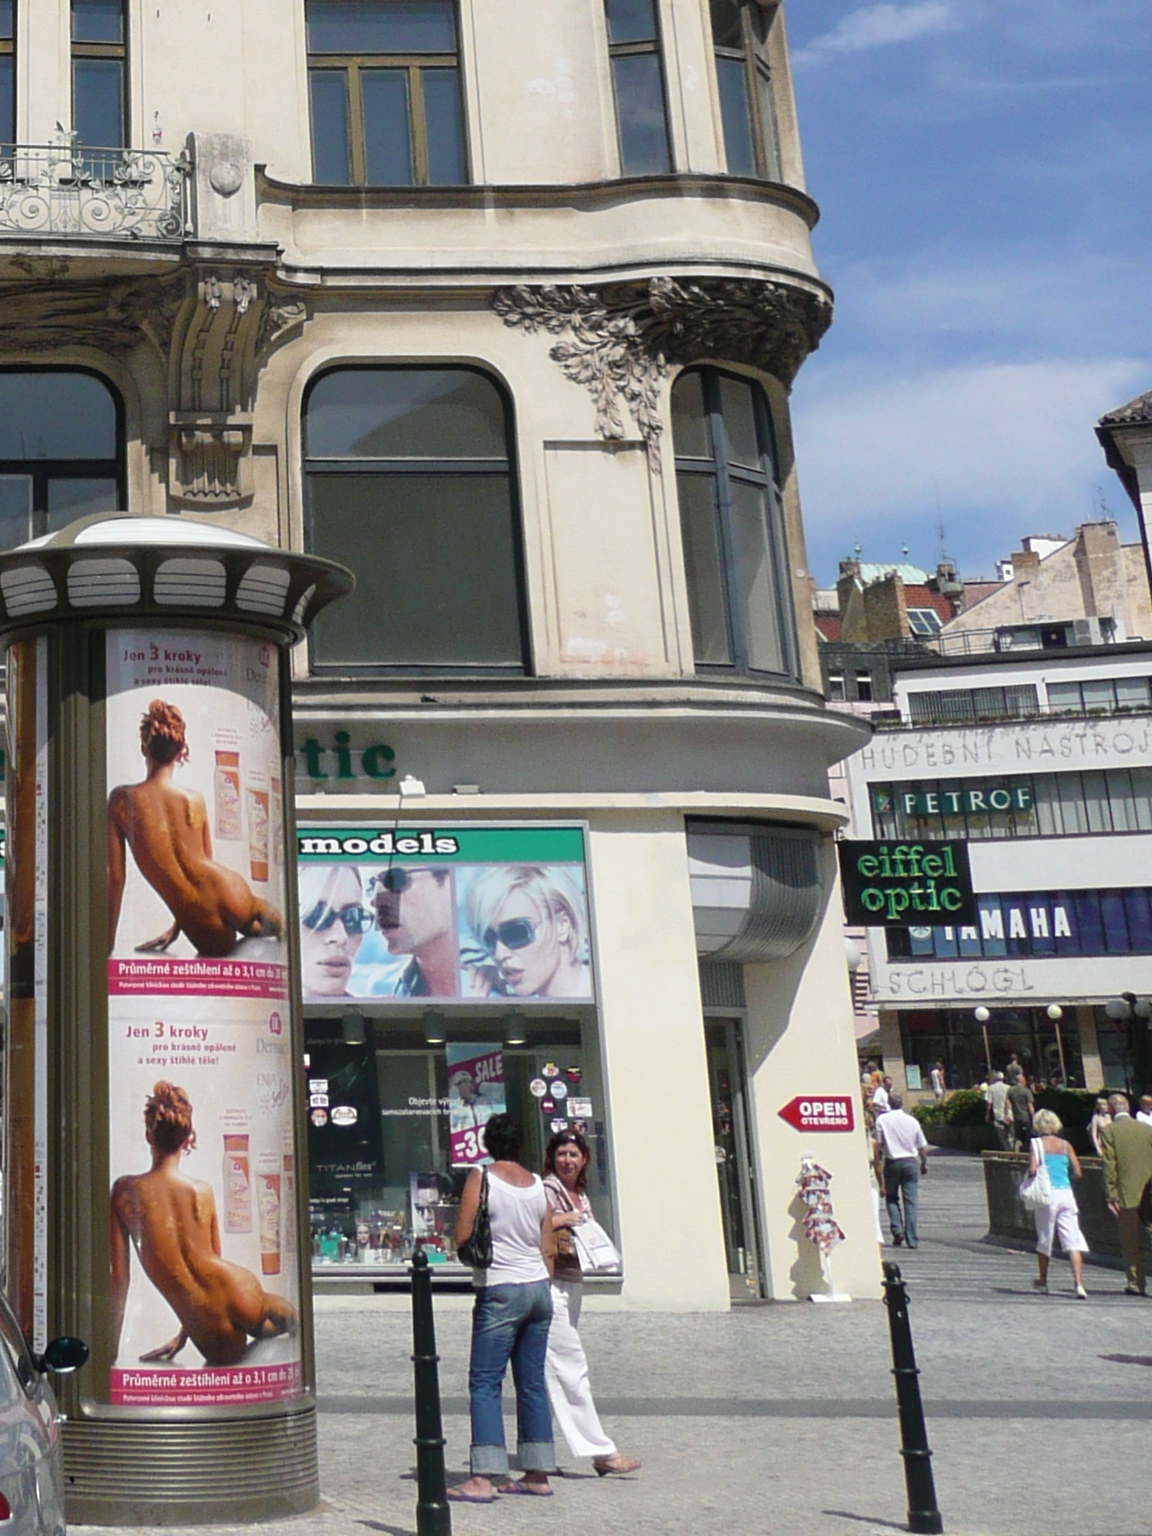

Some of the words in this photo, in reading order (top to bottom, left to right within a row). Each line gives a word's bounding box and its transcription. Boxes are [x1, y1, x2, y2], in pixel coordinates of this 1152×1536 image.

[123, 649, 145, 661] Jen
[150, 645, 159, 661] 3
[164, 649, 201, 664] kroky
[148, 666, 163, 675] pro
[904, 788, 1030, 814] PETROF
[301, 833, 458, 855] models
[857, 845, 958, 879] eiffel
[861, 880, 963, 920] optic
[119, 963, 170, 975] Průměrné
[173, 962, 221, 976] zeštíhlení
[223, 964, 233, 977] až
[242, 966, 254, 979] 3,1
[126, 1025, 149, 1038] Jen
[154, 1021, 164, 1038] 3
[170, 1025, 208, 1040] kroky
[152, 1044, 168, 1053] pro
[204, 1043, 237, 1053] opálené
[146, 1057, 167, 1066] sexy
[198, 1056, 219, 1065] tělo!
[475, 1054, 503, 1084] SALE
[799, 1101, 847, 1116] OPEN
[123, 1372, 177, 1387] Průměrné
[180, 1372, 230, 1386] zeštíhlení
[233, 1371, 243, 1384] až
[254, 1371, 266, 1385] 3,1
